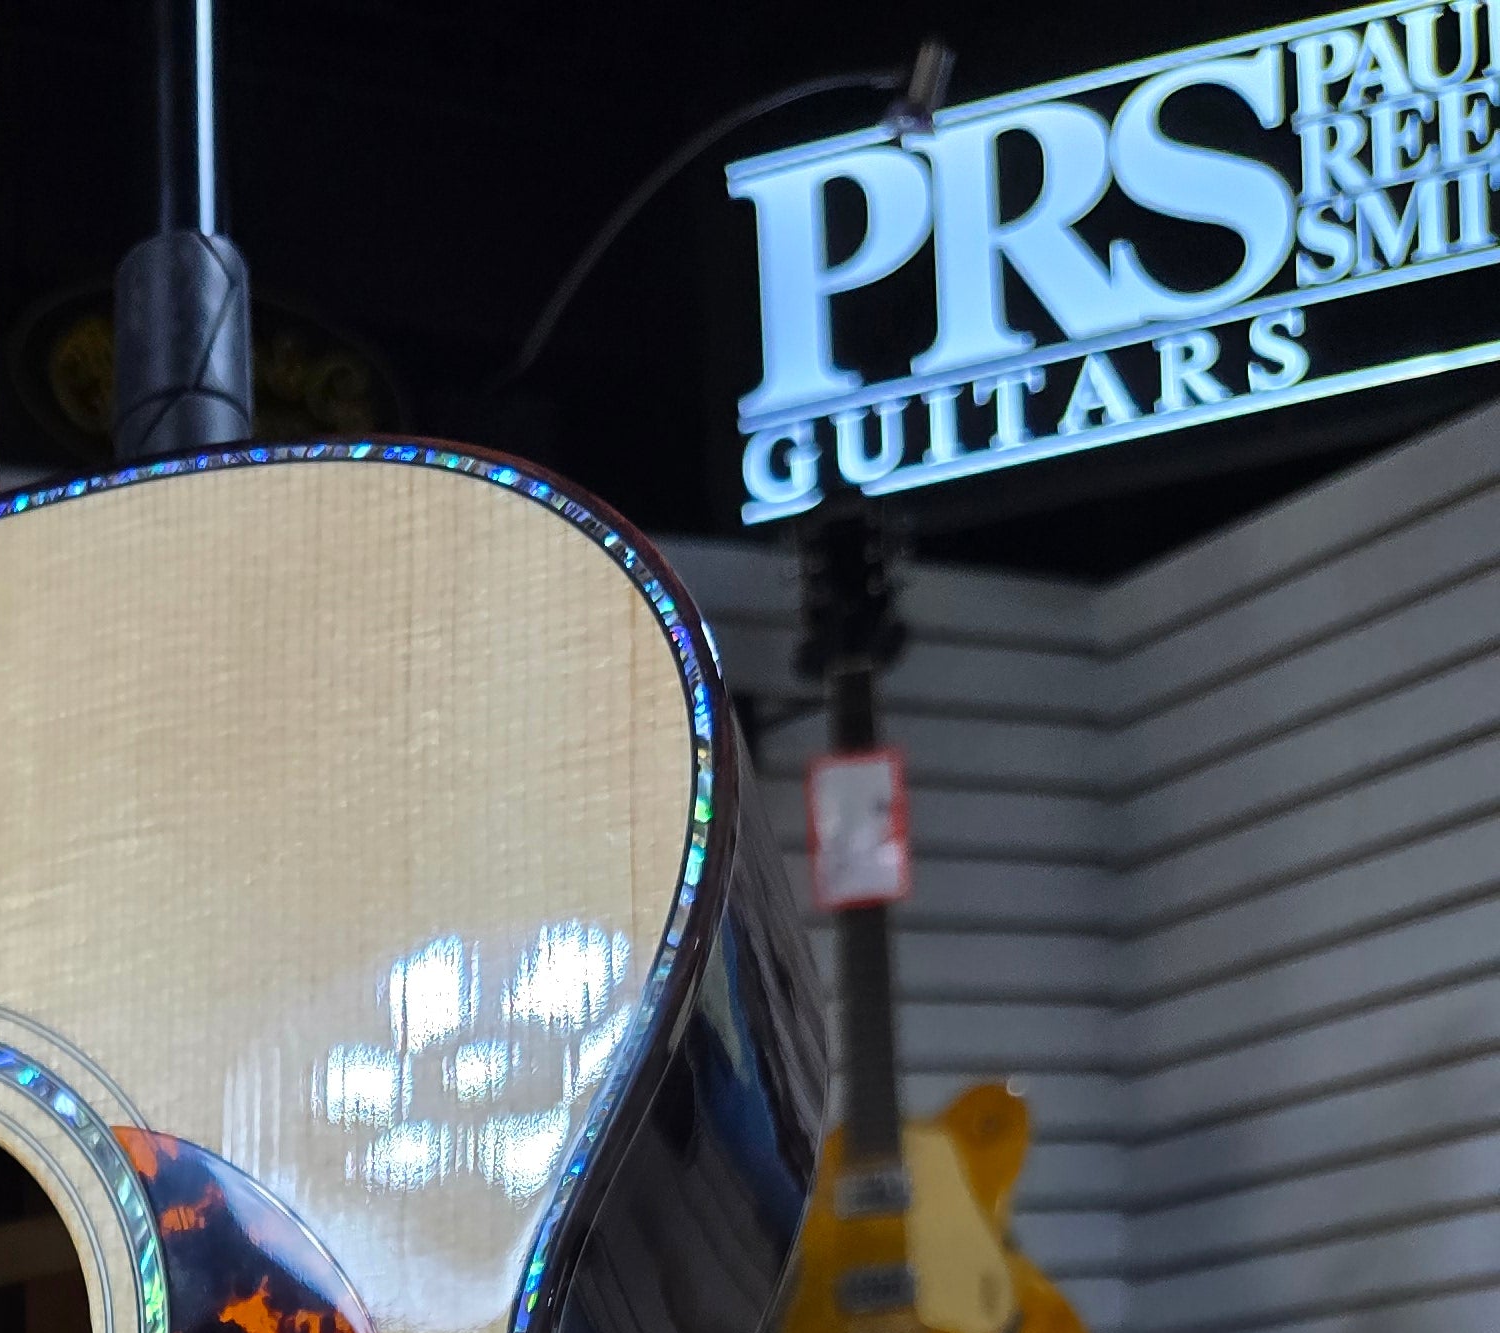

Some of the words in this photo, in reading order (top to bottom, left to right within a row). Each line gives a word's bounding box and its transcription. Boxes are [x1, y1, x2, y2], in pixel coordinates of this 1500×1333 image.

[729, 45, 1298, 412] PRS
[1296, 164, 1500, 287] SMI
[742, 308, 1311, 505] GUITARS
